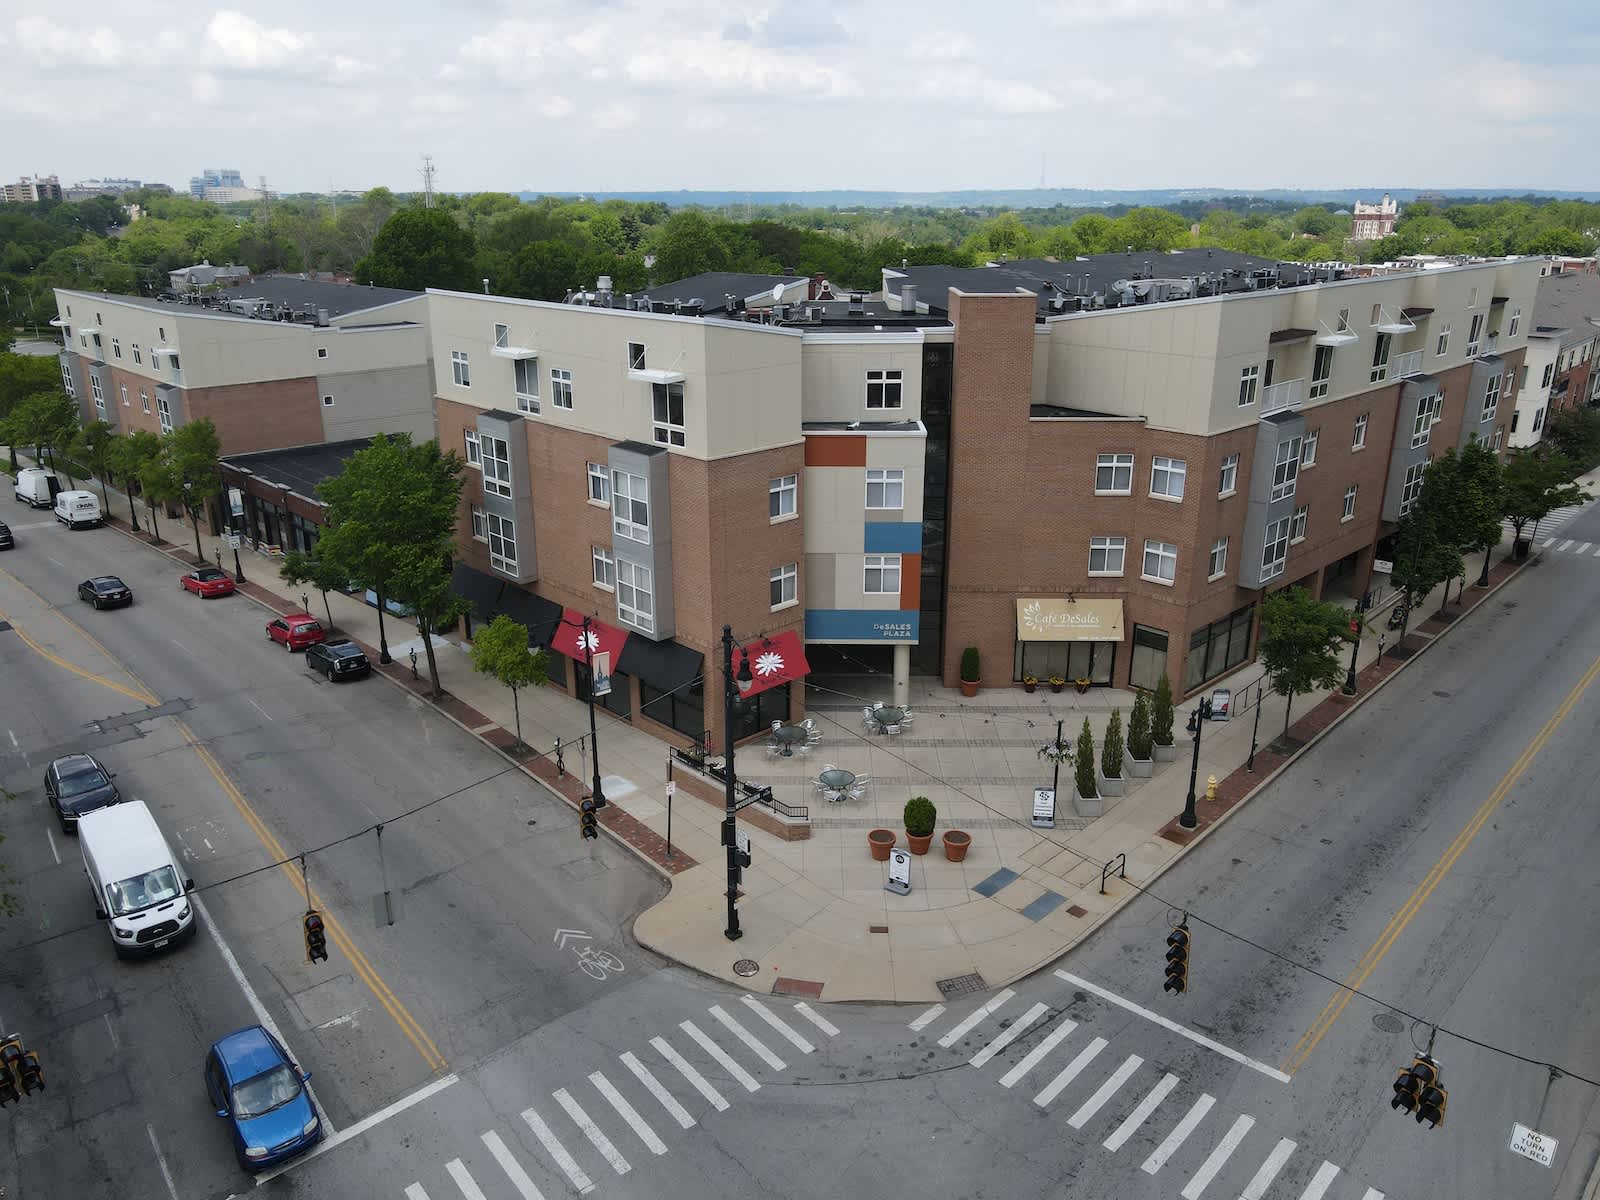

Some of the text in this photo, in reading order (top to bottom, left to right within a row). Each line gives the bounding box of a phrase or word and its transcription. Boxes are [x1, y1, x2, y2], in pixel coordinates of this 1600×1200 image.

[1060, 613, 1100, 624] DeSales
[1521, 1136, 1545, 1152] TURN
[1527, 1132, 1542, 1143] NO
[1513, 1143, 1548, 1162] ON RED
